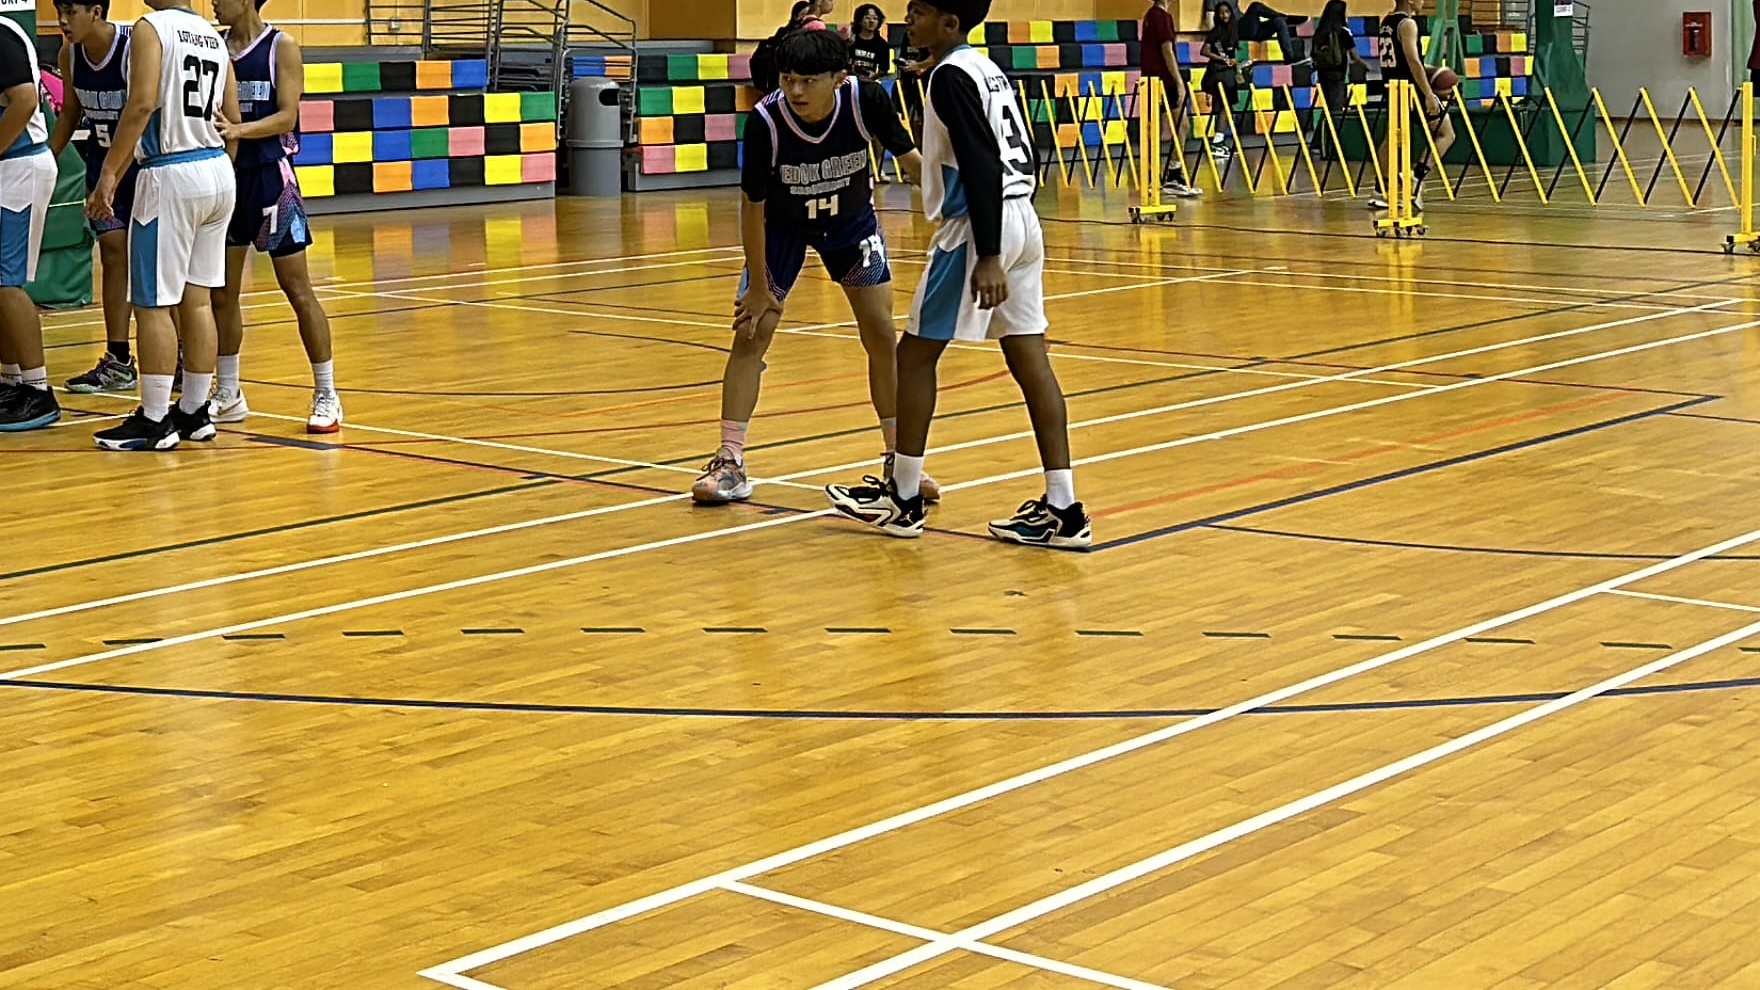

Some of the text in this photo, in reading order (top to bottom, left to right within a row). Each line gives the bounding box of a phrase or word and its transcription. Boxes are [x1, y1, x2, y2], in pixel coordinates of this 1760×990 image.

[183, 54, 219, 121] 27
[95, 124, 112, 148] 5
[805, 194, 839, 219] 14
